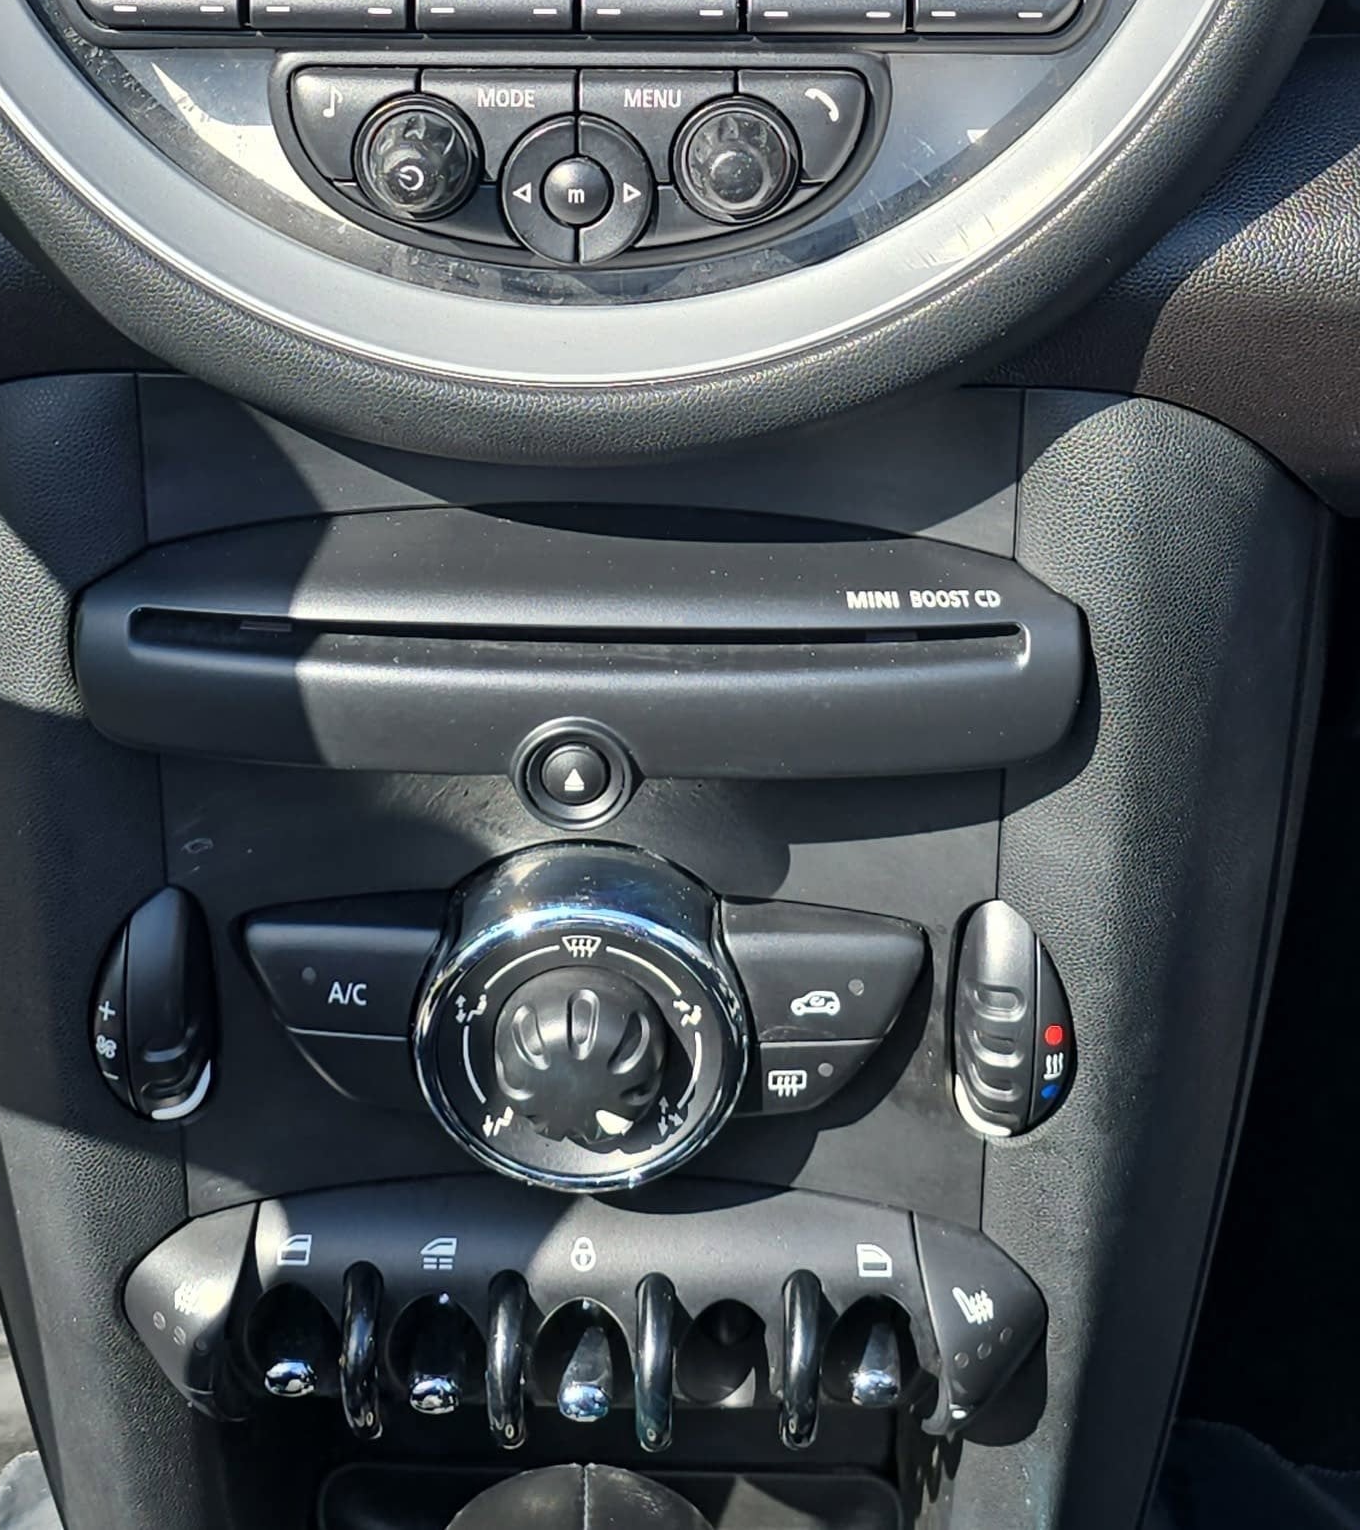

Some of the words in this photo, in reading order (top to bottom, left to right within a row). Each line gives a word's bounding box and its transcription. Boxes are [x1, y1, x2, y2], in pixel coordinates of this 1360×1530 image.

[476, 88, 536, 109] MODE
[623, 88, 683, 109] MENU
[567, 187, 586, 204] m
[846, 590, 900, 609] MINI
[909, 589, 970, 608] BOOST
[974, 589, 1002, 608] CD
[327, 981, 367, 1006] A/C
